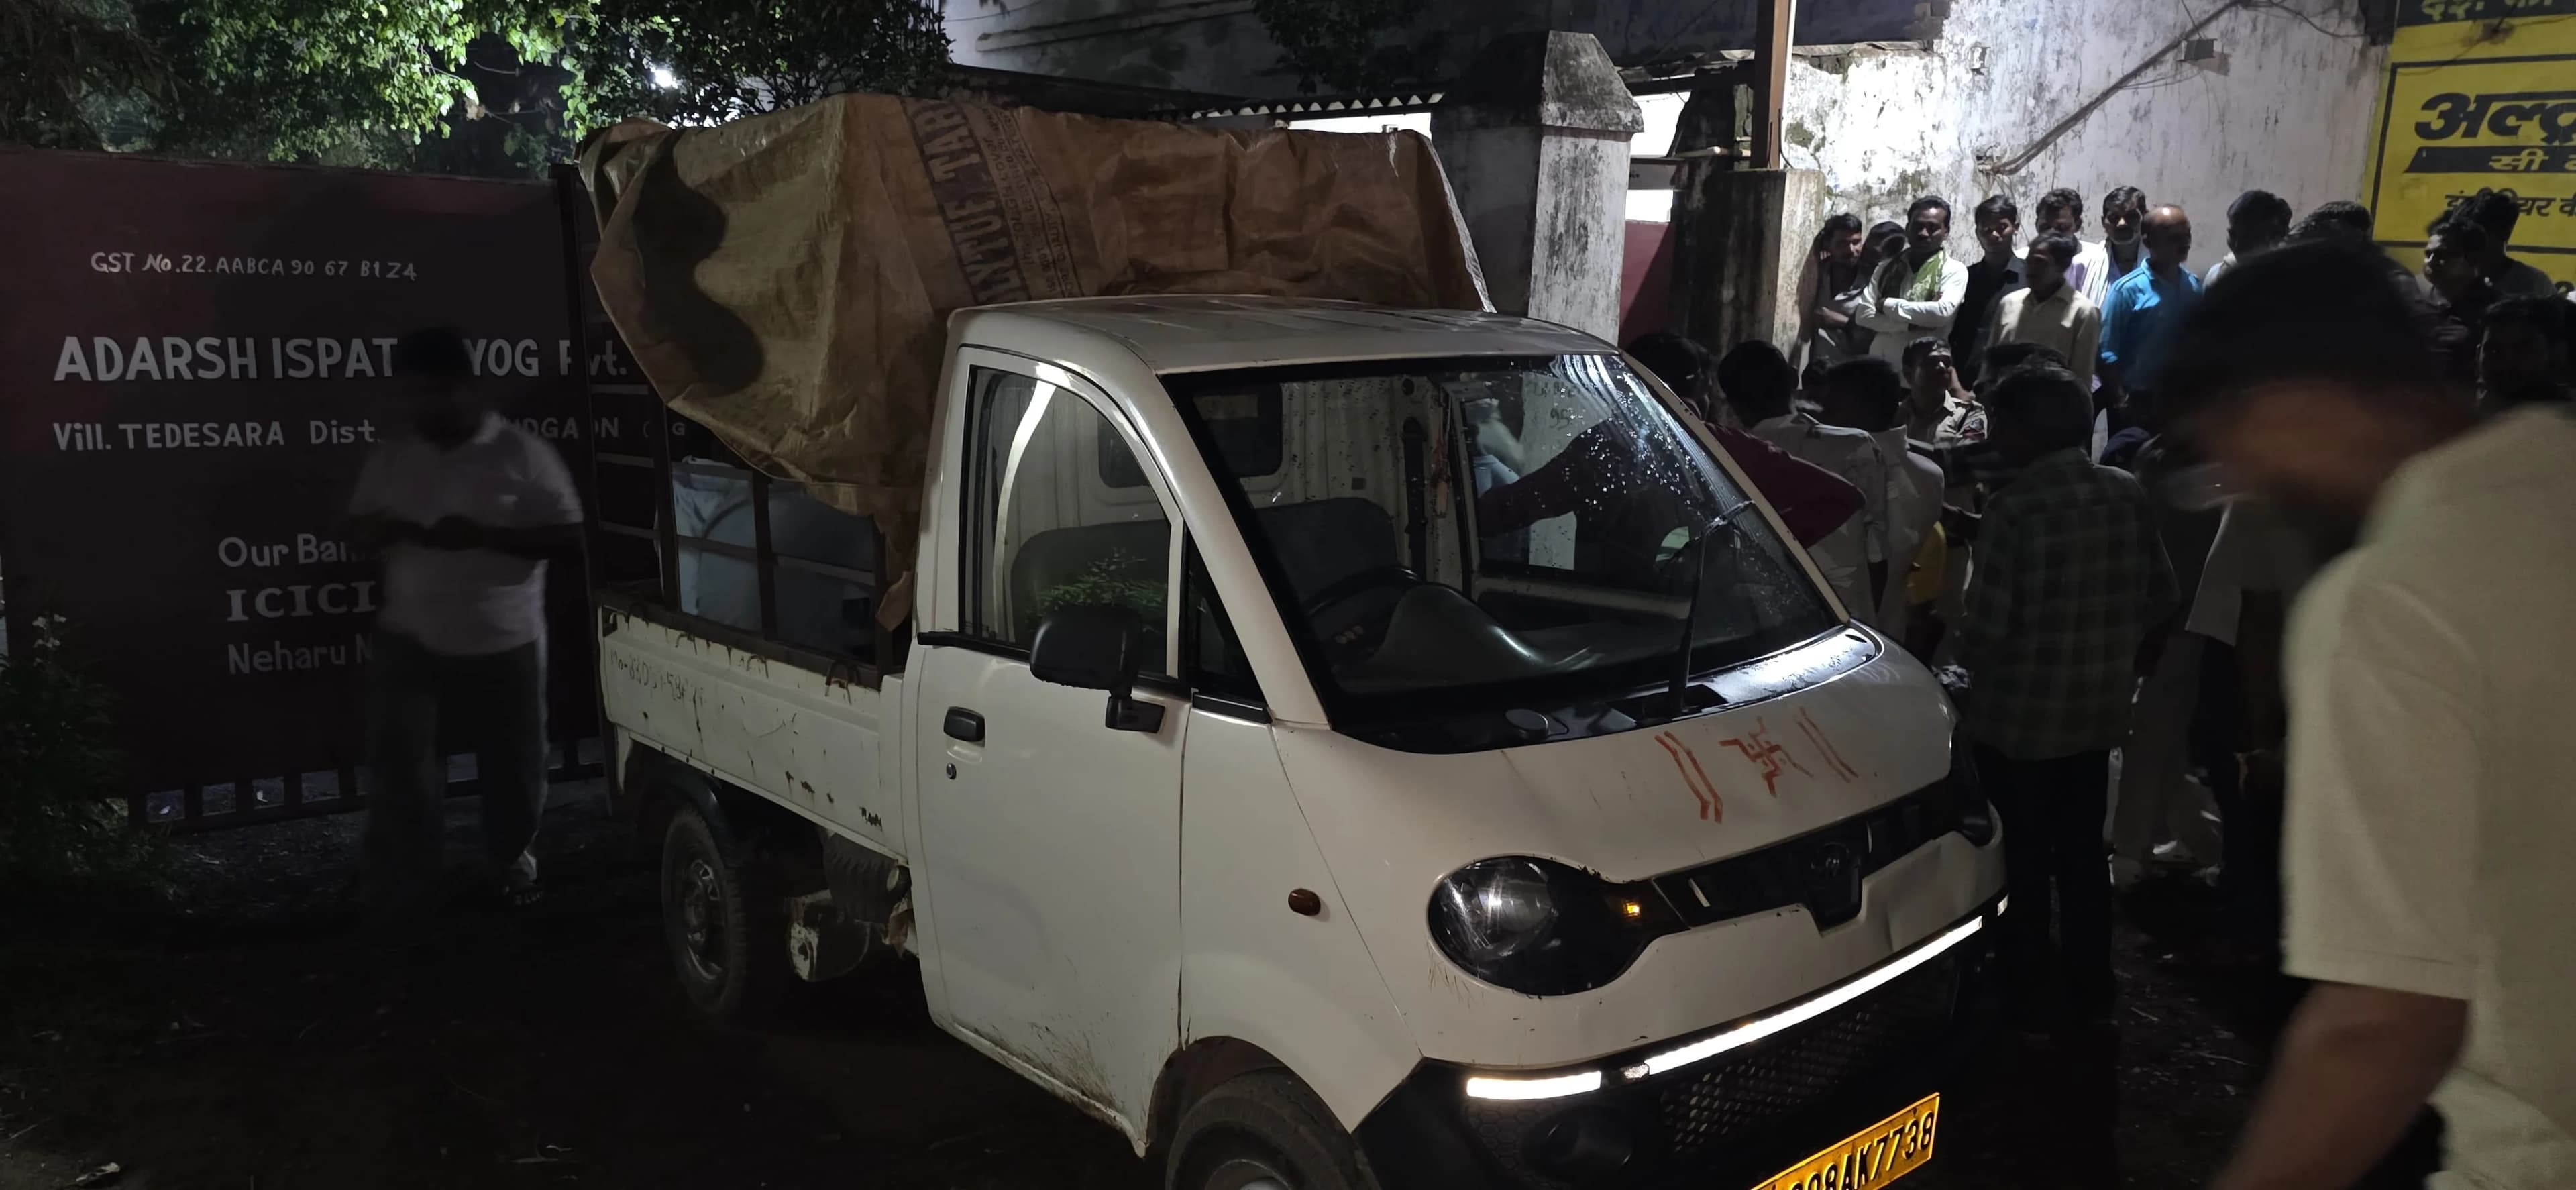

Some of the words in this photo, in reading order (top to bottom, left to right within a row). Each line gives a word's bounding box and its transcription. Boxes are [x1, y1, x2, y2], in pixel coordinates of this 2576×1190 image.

[91, 252, 136, 273] GST
[54, 336, 258, 381] ADARSH
[272, 337, 398, 380] ISPAT
[53, 423, 112, 451] Vill.
[119, 421, 284, 449] TEDESARA
[218, 537, 289, 567] Our
[226, 580, 376, 622] ICICI
[227, 640, 346, 675] Neharu
